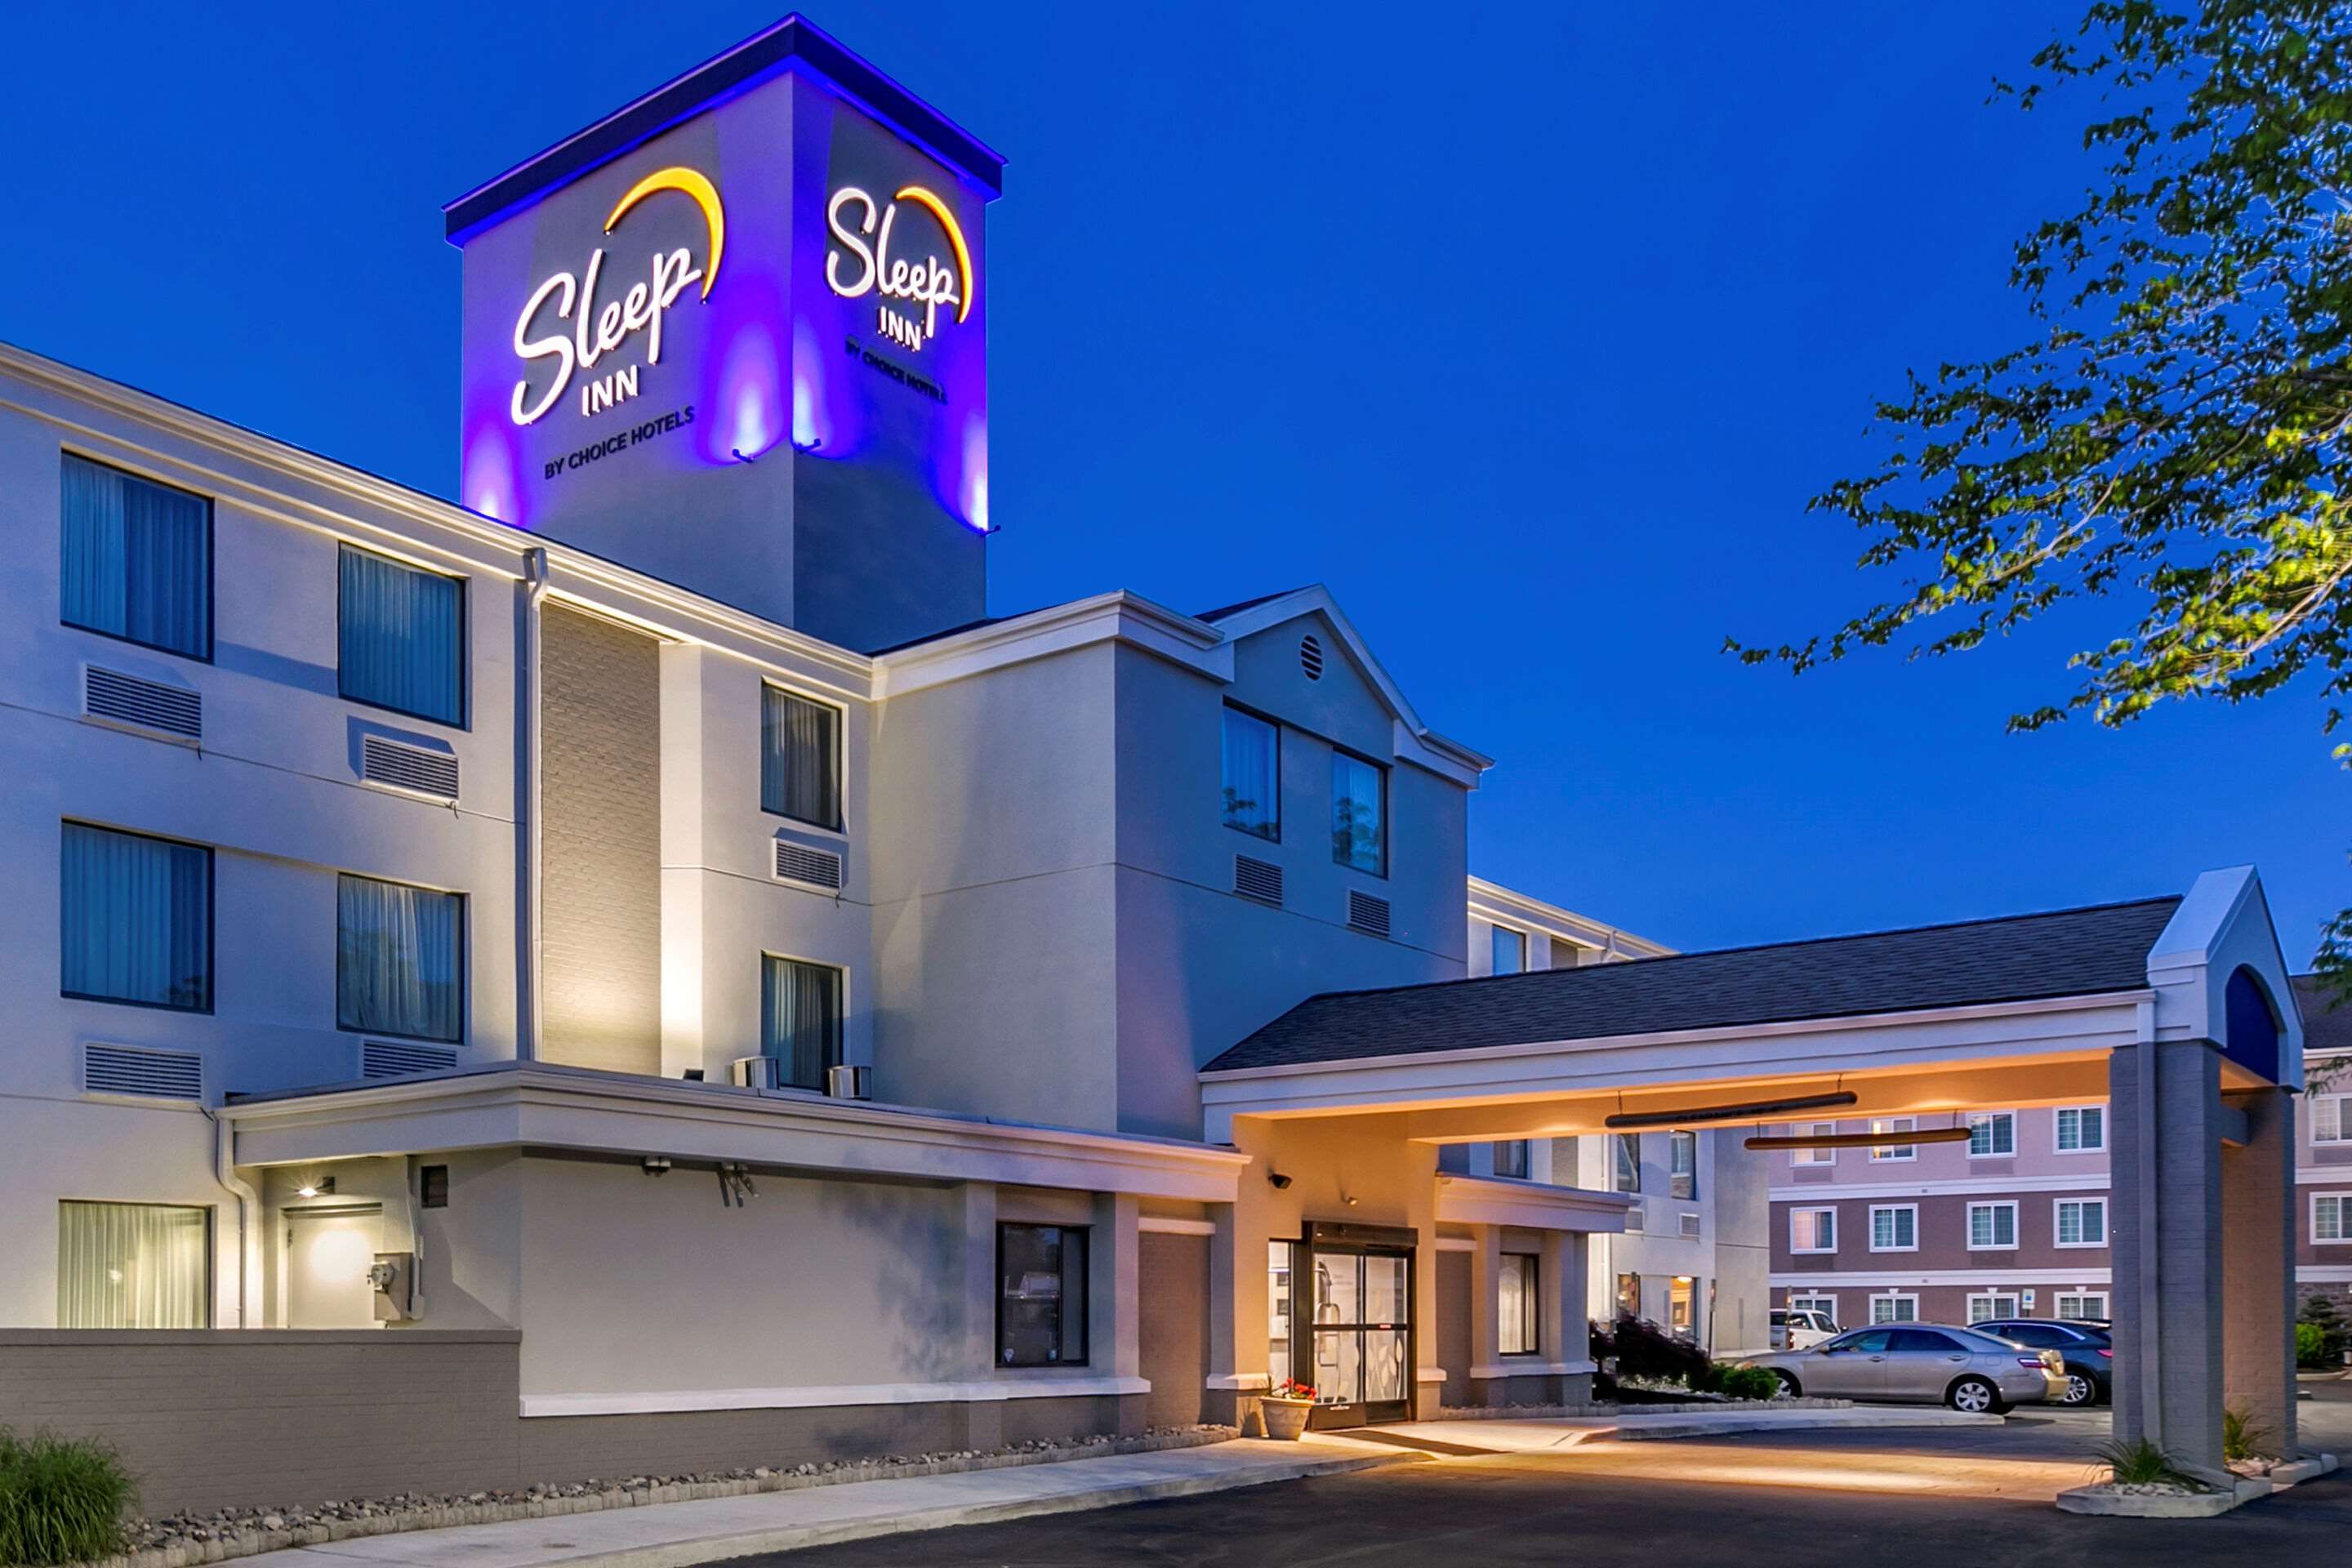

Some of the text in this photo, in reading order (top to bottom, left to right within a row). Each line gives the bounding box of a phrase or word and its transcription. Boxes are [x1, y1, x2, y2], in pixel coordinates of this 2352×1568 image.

[826, 187, 960, 338] Sleep
[510, 248, 702, 425] Sleep
[880, 305, 921, 351] INN
[582, 365, 639, 417] INN
[545, 406, 695, 480] BY CHOICE HOTELS
